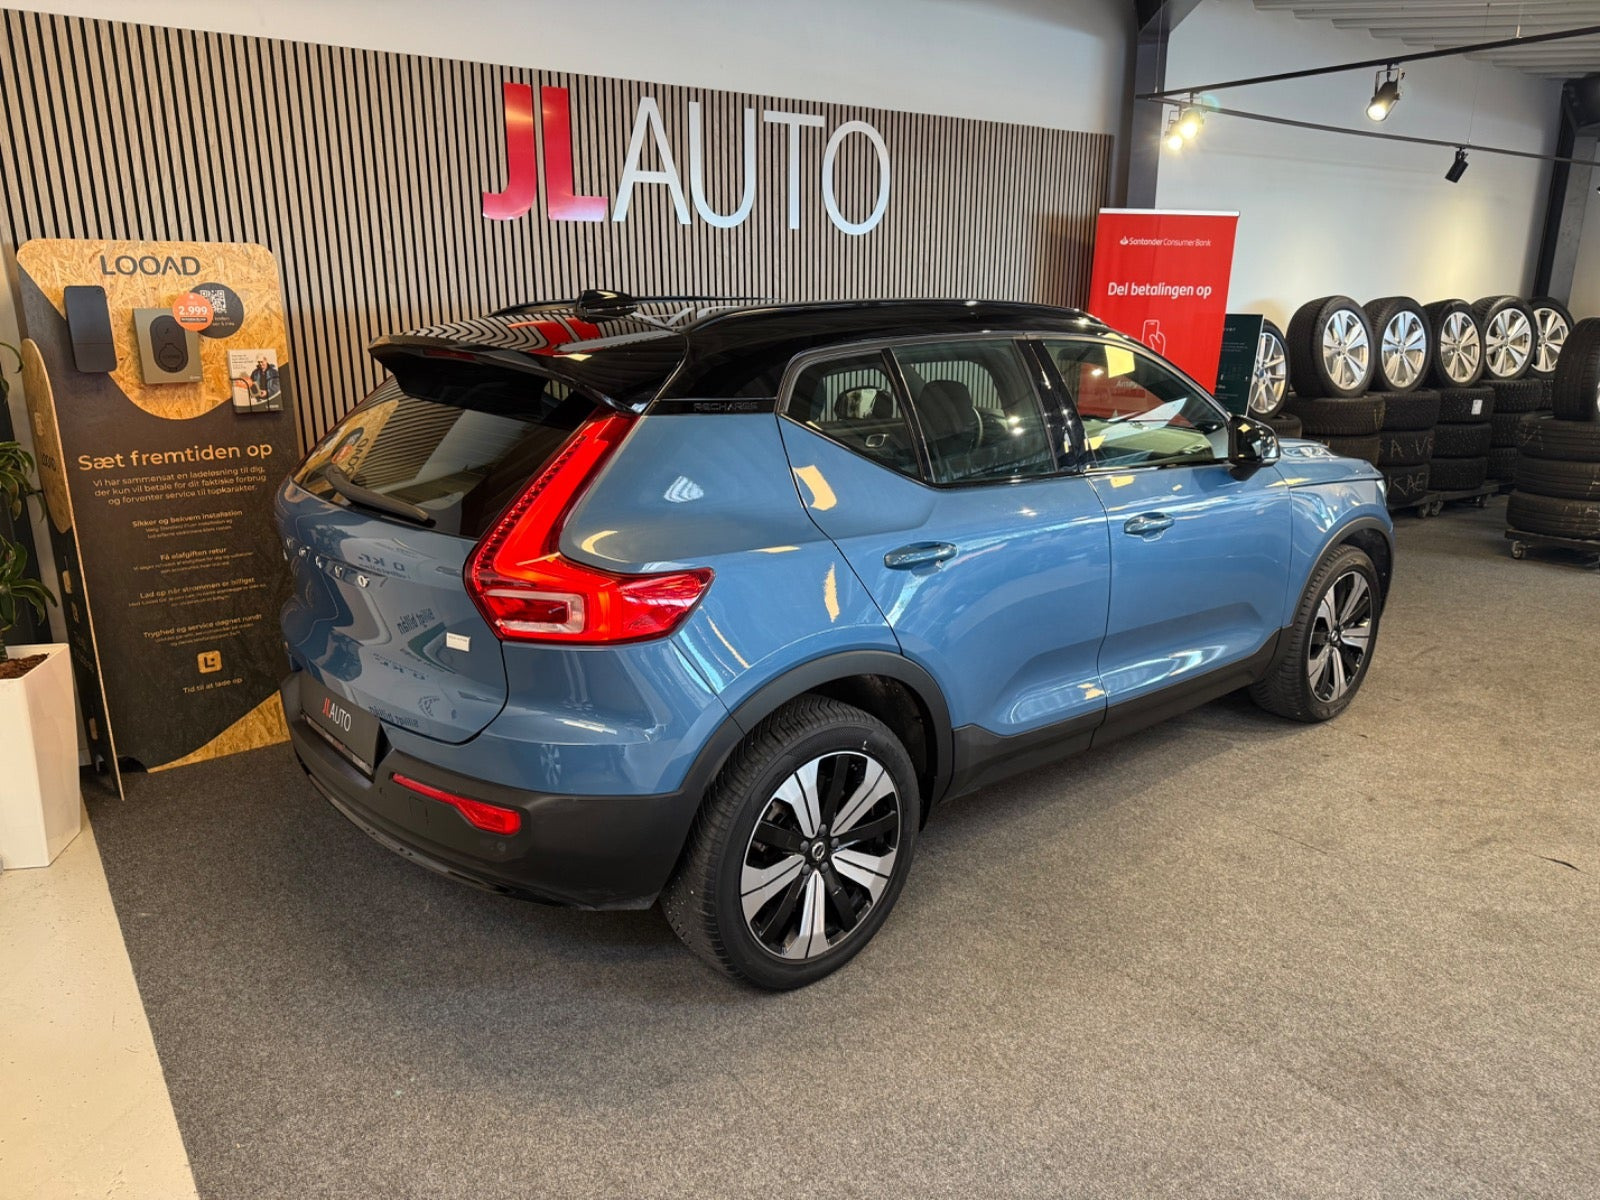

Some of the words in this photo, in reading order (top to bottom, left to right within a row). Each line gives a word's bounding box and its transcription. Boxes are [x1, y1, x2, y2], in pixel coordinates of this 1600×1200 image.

[100, 254, 201, 276] LOOAD
[1107, 282, 1129, 296] Del
[1130, 282, 1195, 300] betalingen
[1196, 285, 1212, 300] op
[178, 305, 208, 317] 2.999
[78, 454, 126, 471] Sæt
[130, 444, 242, 467] fremtiden
[246, 443, 273, 460] op
[93, 480, 103, 488] Vi
[104, 479, 120, 487] har
[122, 474, 175, 485] sammensat
[240, 466, 249, 474] til
[95, 489, 111, 497] der
[112, 487, 131, 496] kun
[132, 485, 143, 494] vil
[144, 482, 173, 493] betale
[174, 481, 187, 490] for
[188, 479, 200, 488] dit
[201, 477, 235, 487] faktiske
[235, 474, 267, 484] forbrug
[108, 498, 121, 507] og
[122, 493, 163, 504] forventer
[165, 490, 196, 500] service
[197, 488, 207, 497] til
